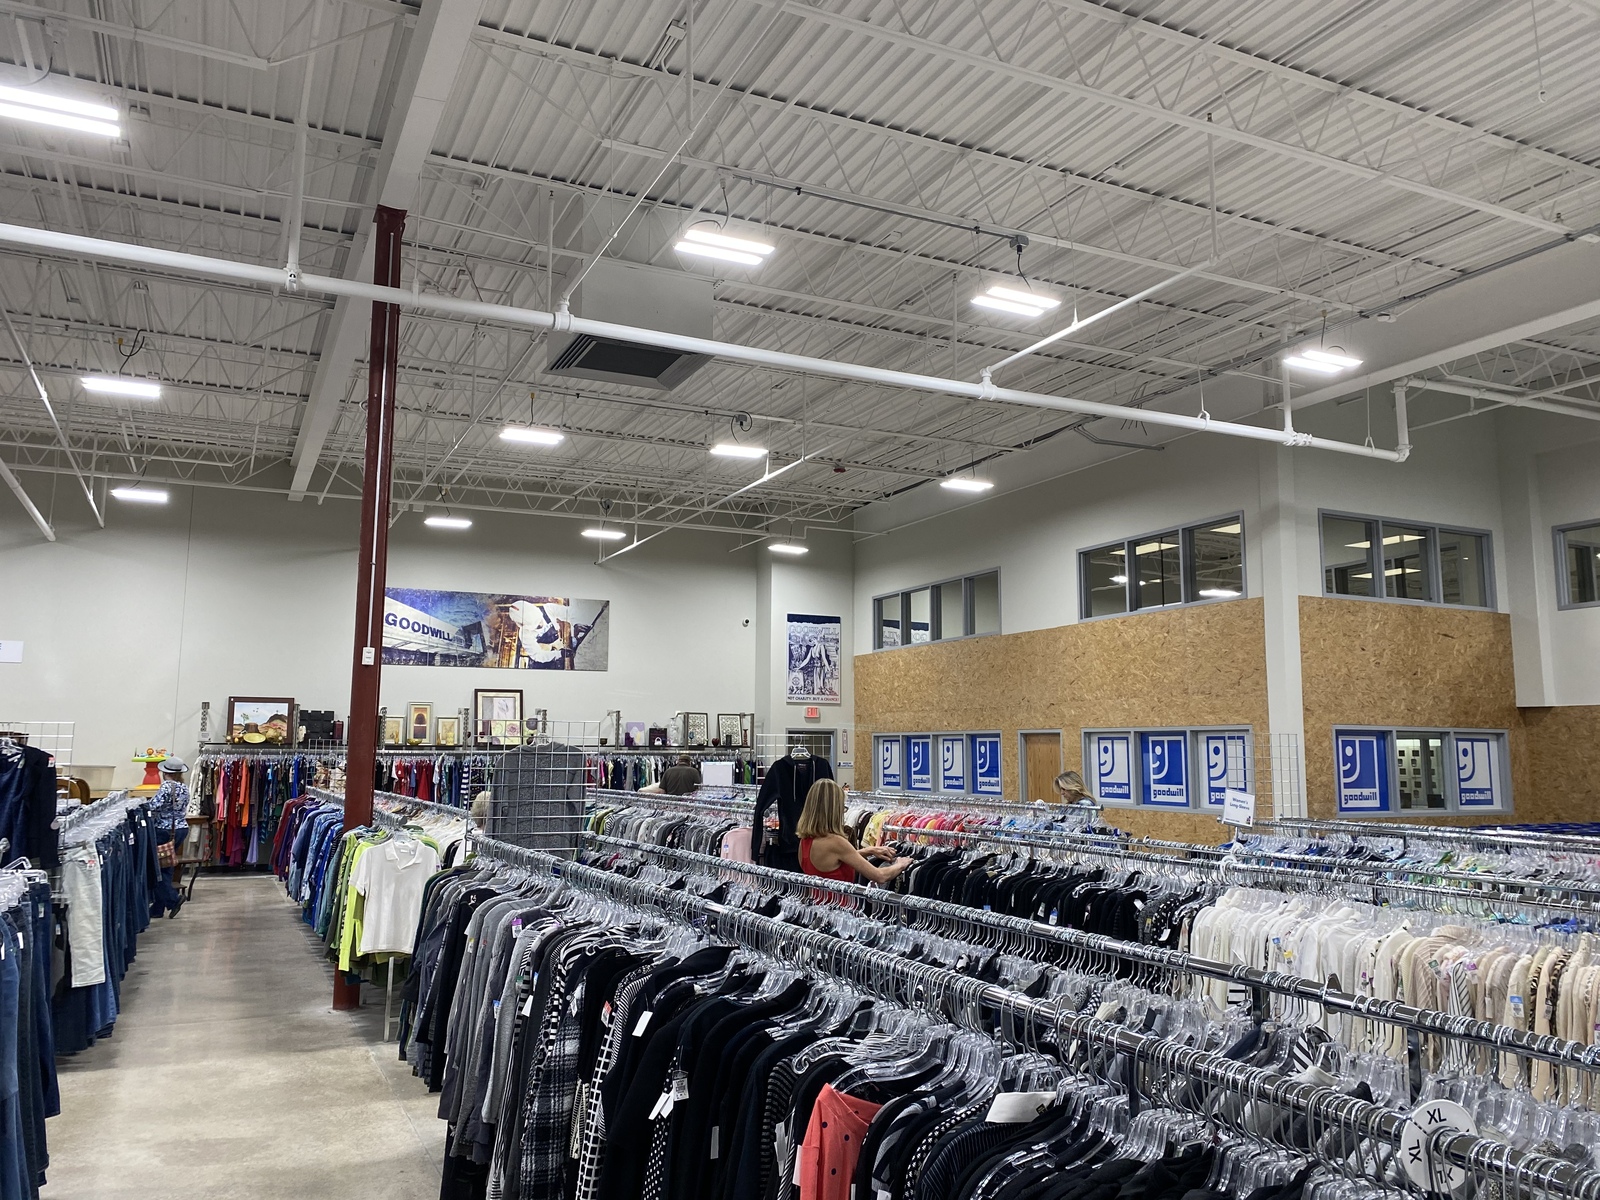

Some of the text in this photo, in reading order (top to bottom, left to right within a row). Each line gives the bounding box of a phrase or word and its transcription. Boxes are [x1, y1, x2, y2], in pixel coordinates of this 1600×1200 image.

[385, 612, 452, 642] GOODWILL
[806, 707, 818, 717] EXIT
[883, 776, 900, 784] goodwill
[912, 776, 930, 785] goodwill
[944, 778, 963, 787] goodwill
[979, 780, 999, 789] goodwill
[1101, 785, 1129, 796] goodwill
[1153, 787, 1184, 799] goodwill
[1344, 791, 1377, 804] goodwill
[1461, 790, 1492, 803] goodwill
[1426, 1107, 1447, 1125] XL
[1408, 1139, 1422, 1164] XL
